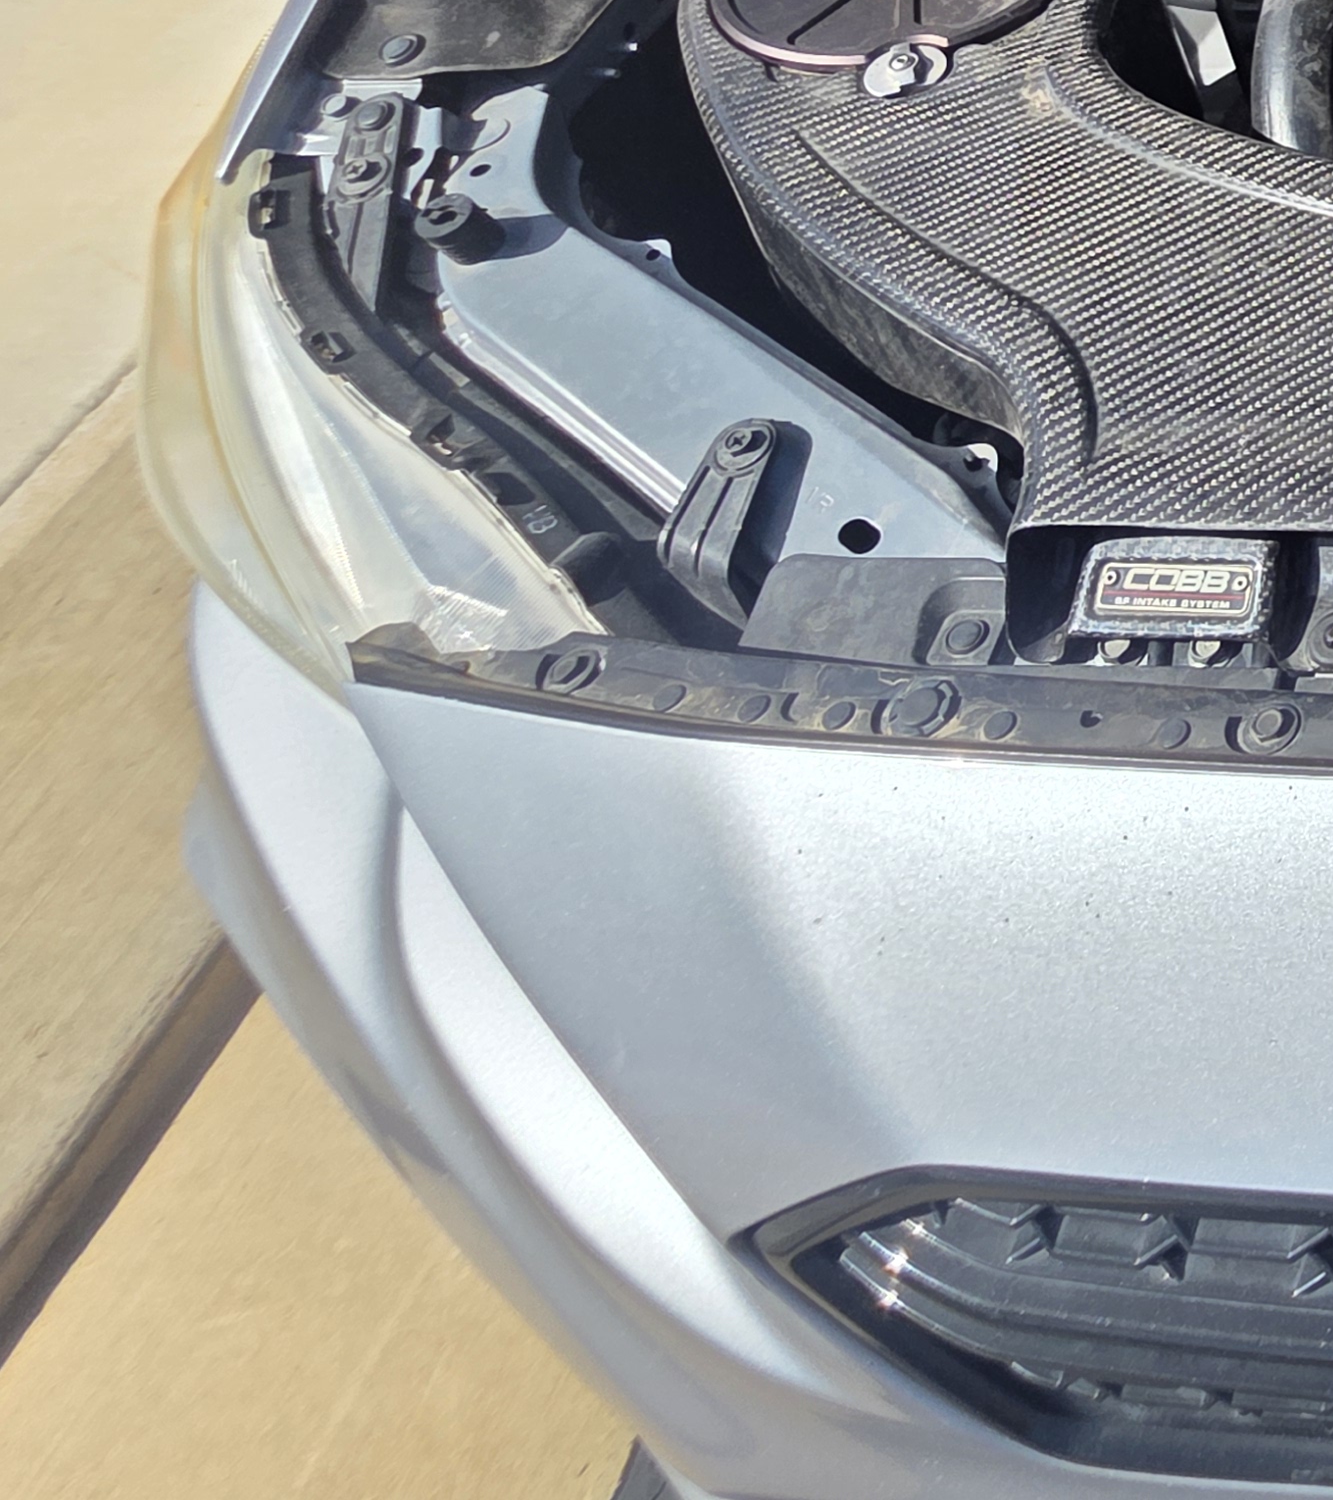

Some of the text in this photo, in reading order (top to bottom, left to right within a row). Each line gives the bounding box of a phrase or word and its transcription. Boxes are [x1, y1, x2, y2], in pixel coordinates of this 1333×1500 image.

[1122, 567, 1231, 594] COBB
[1132, 597, 1178, 608] INTAKE
[1180, 599, 1231, 609] SYSTEM
